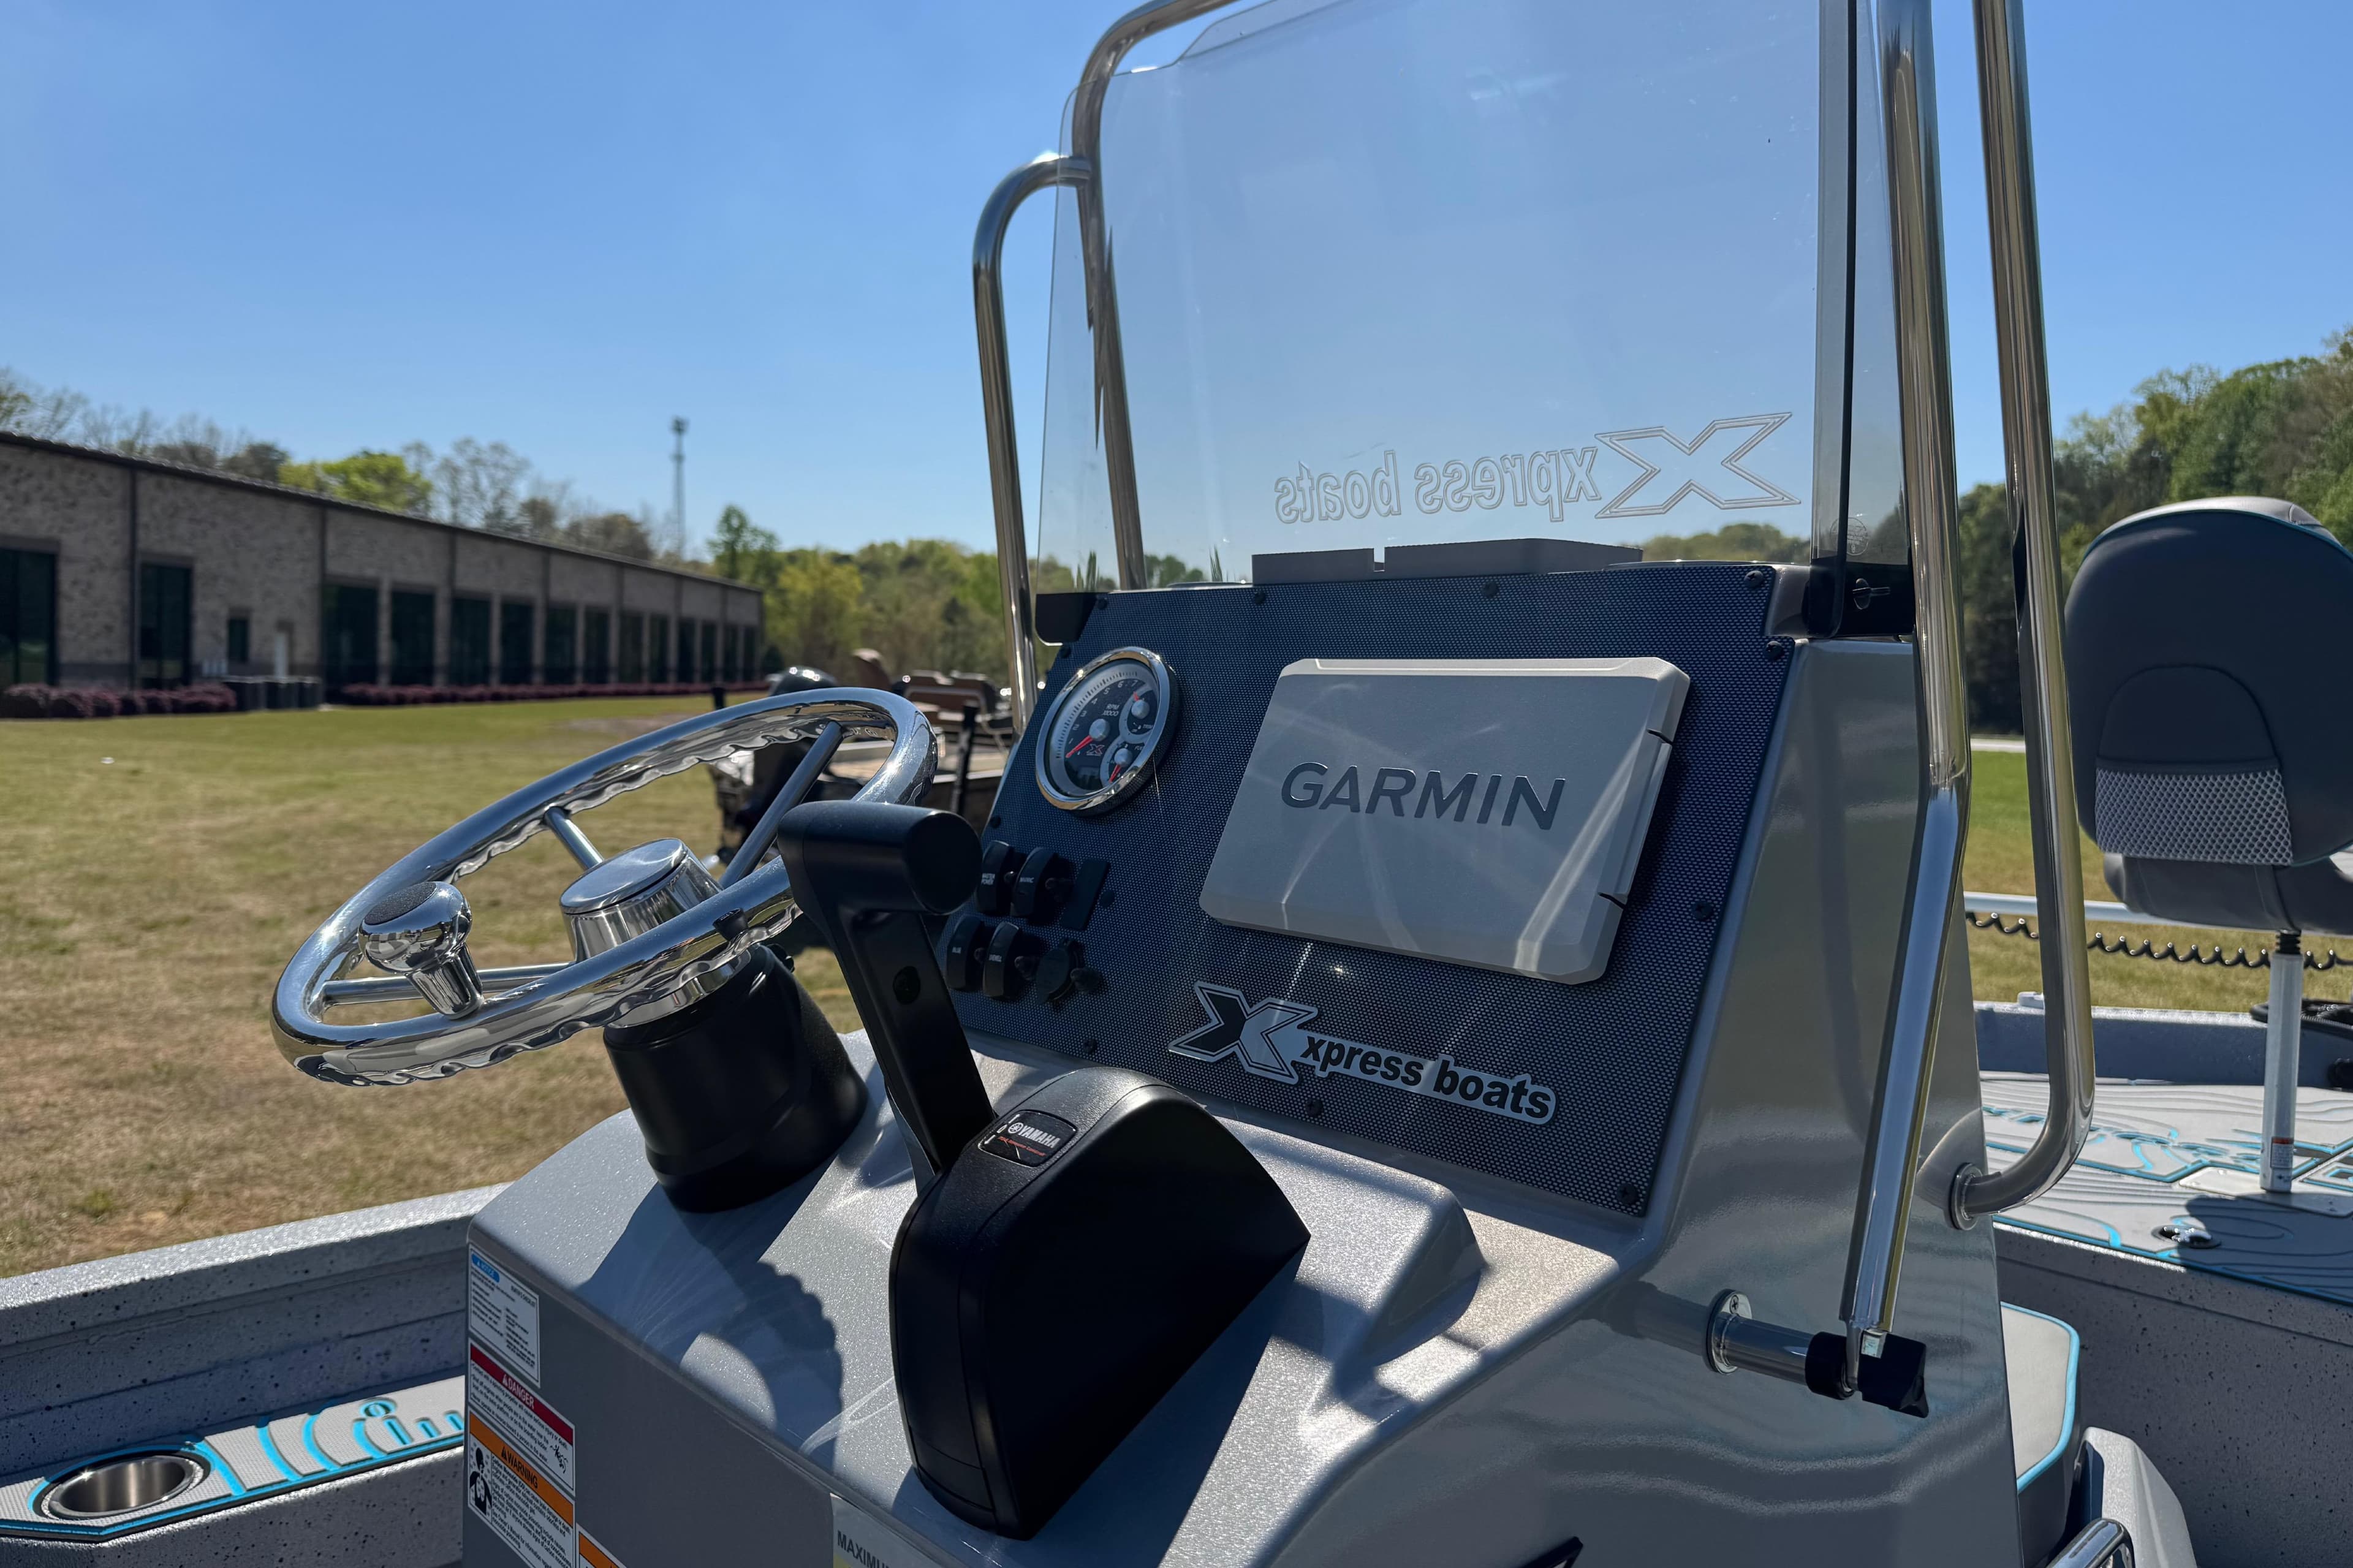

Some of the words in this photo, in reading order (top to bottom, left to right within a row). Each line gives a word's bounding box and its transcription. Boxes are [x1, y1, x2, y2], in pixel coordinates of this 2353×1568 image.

[1281, 762, 1566, 830] GARMIN
[1300, 1036, 1422, 1086] xpress
[1433, 1059, 1551, 1119] boats
[1018, 1125, 1061, 1148] YAMAHA
[508, 1378, 534, 1410] DANGER
[508, 1450, 539, 1489] WARNING
[838, 1529, 890, 1568] MAXIM
